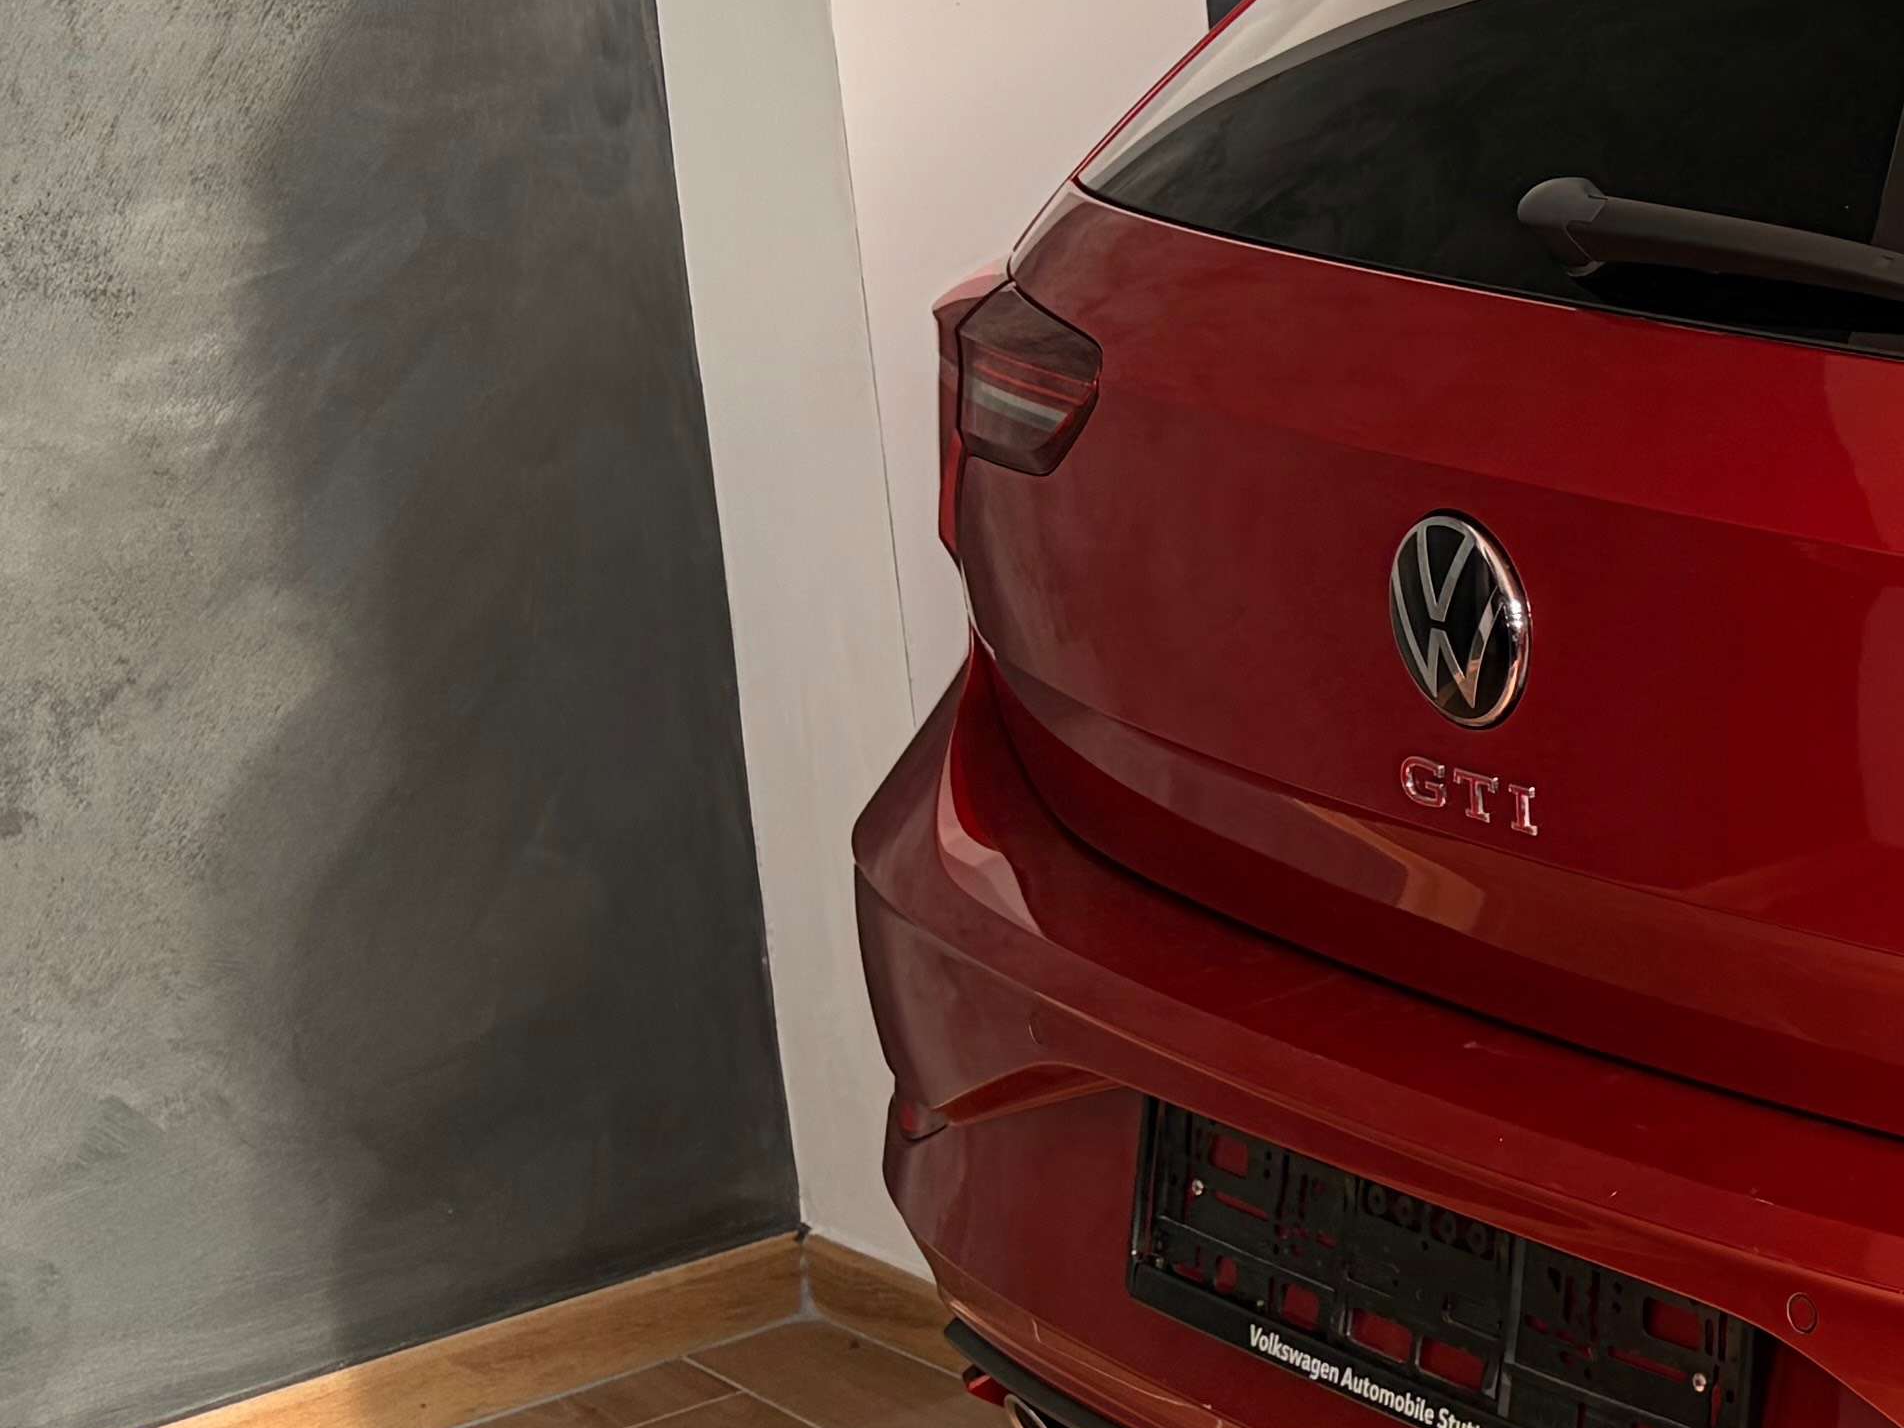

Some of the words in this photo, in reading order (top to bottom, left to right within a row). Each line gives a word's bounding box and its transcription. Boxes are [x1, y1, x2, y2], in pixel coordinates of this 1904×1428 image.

[1400, 756, 1538, 836] GTI
[1250, 1324, 1339, 1384] Volkswagen
[1341, 1367, 1434, 1425] Automobile
